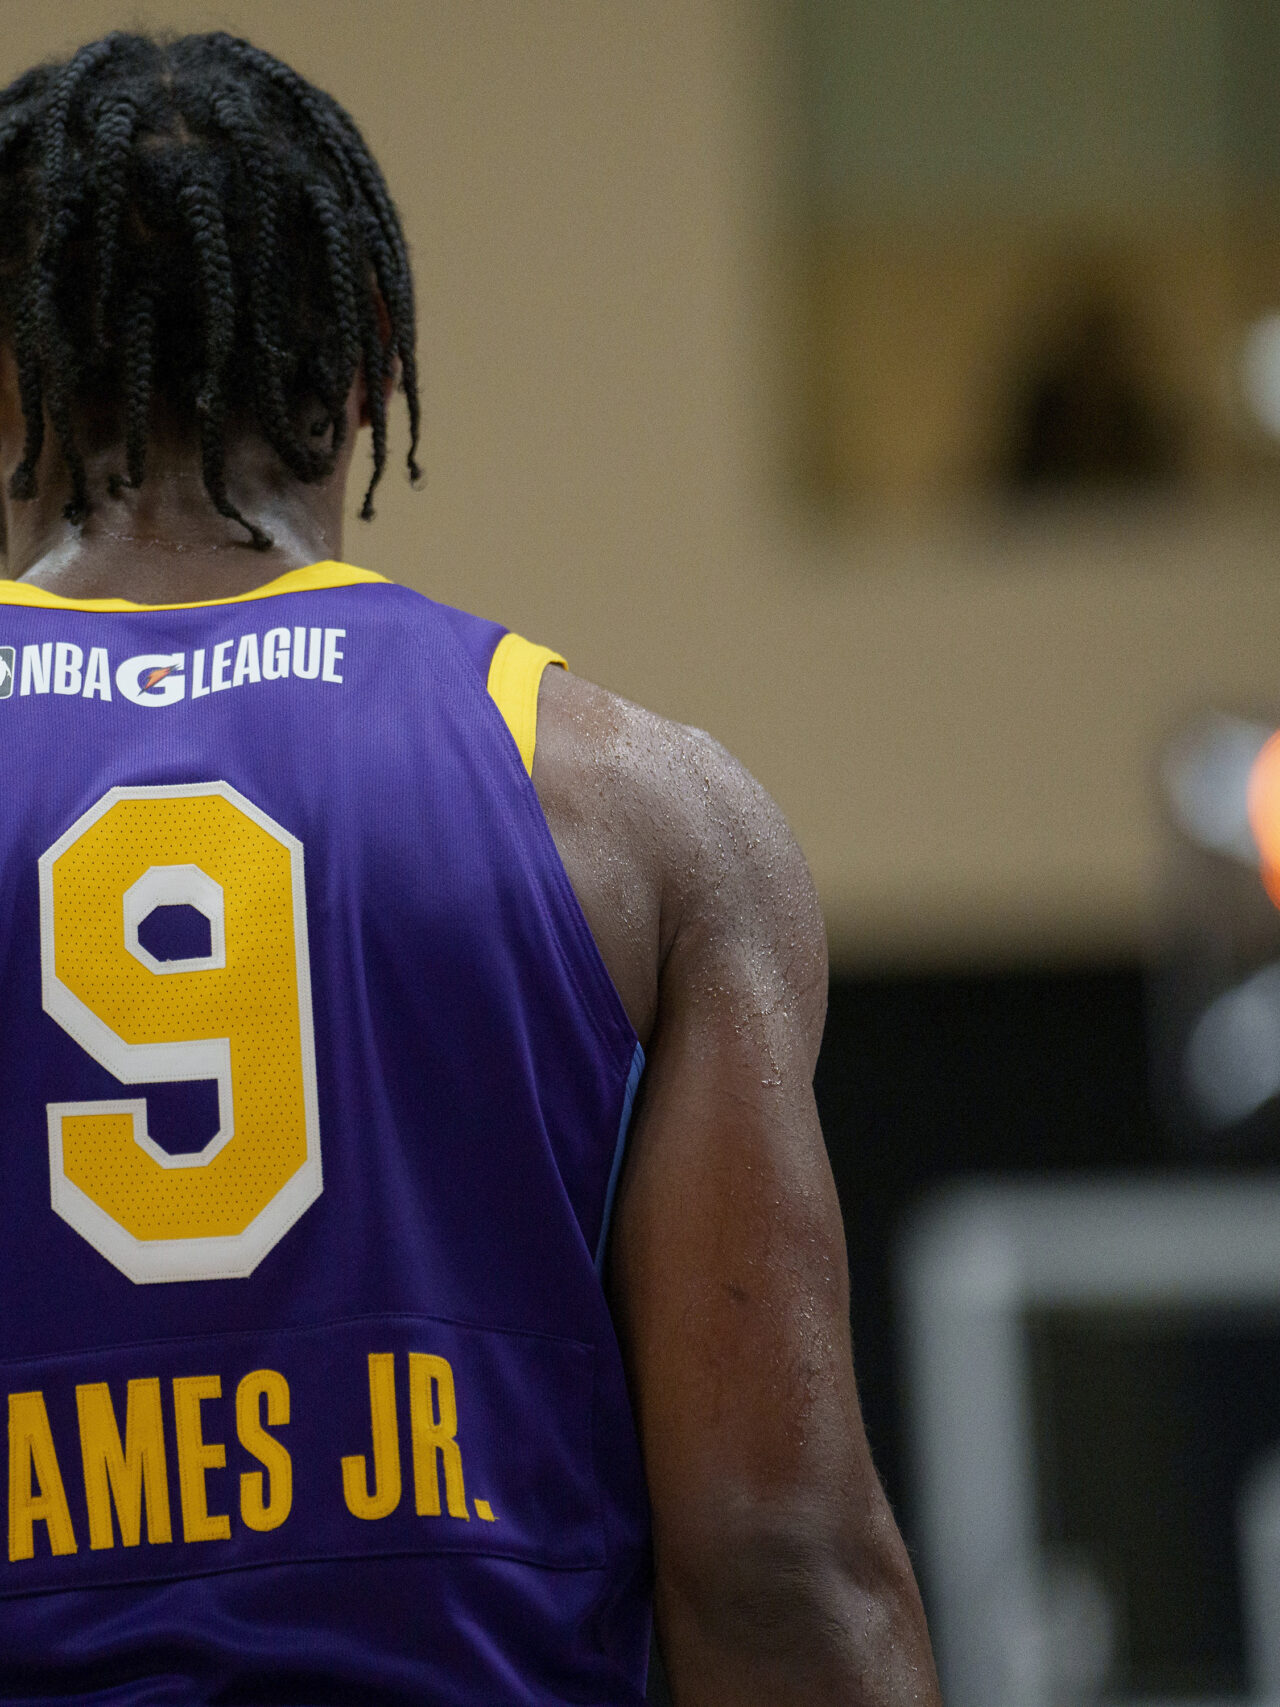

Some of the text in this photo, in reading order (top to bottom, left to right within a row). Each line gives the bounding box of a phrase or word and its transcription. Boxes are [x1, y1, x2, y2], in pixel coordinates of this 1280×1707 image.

[19, 625, 347, 708] NBA G LEAGUE
[37, 779, 324, 1285] 9
[340, 1351, 499, 1523] JR.
